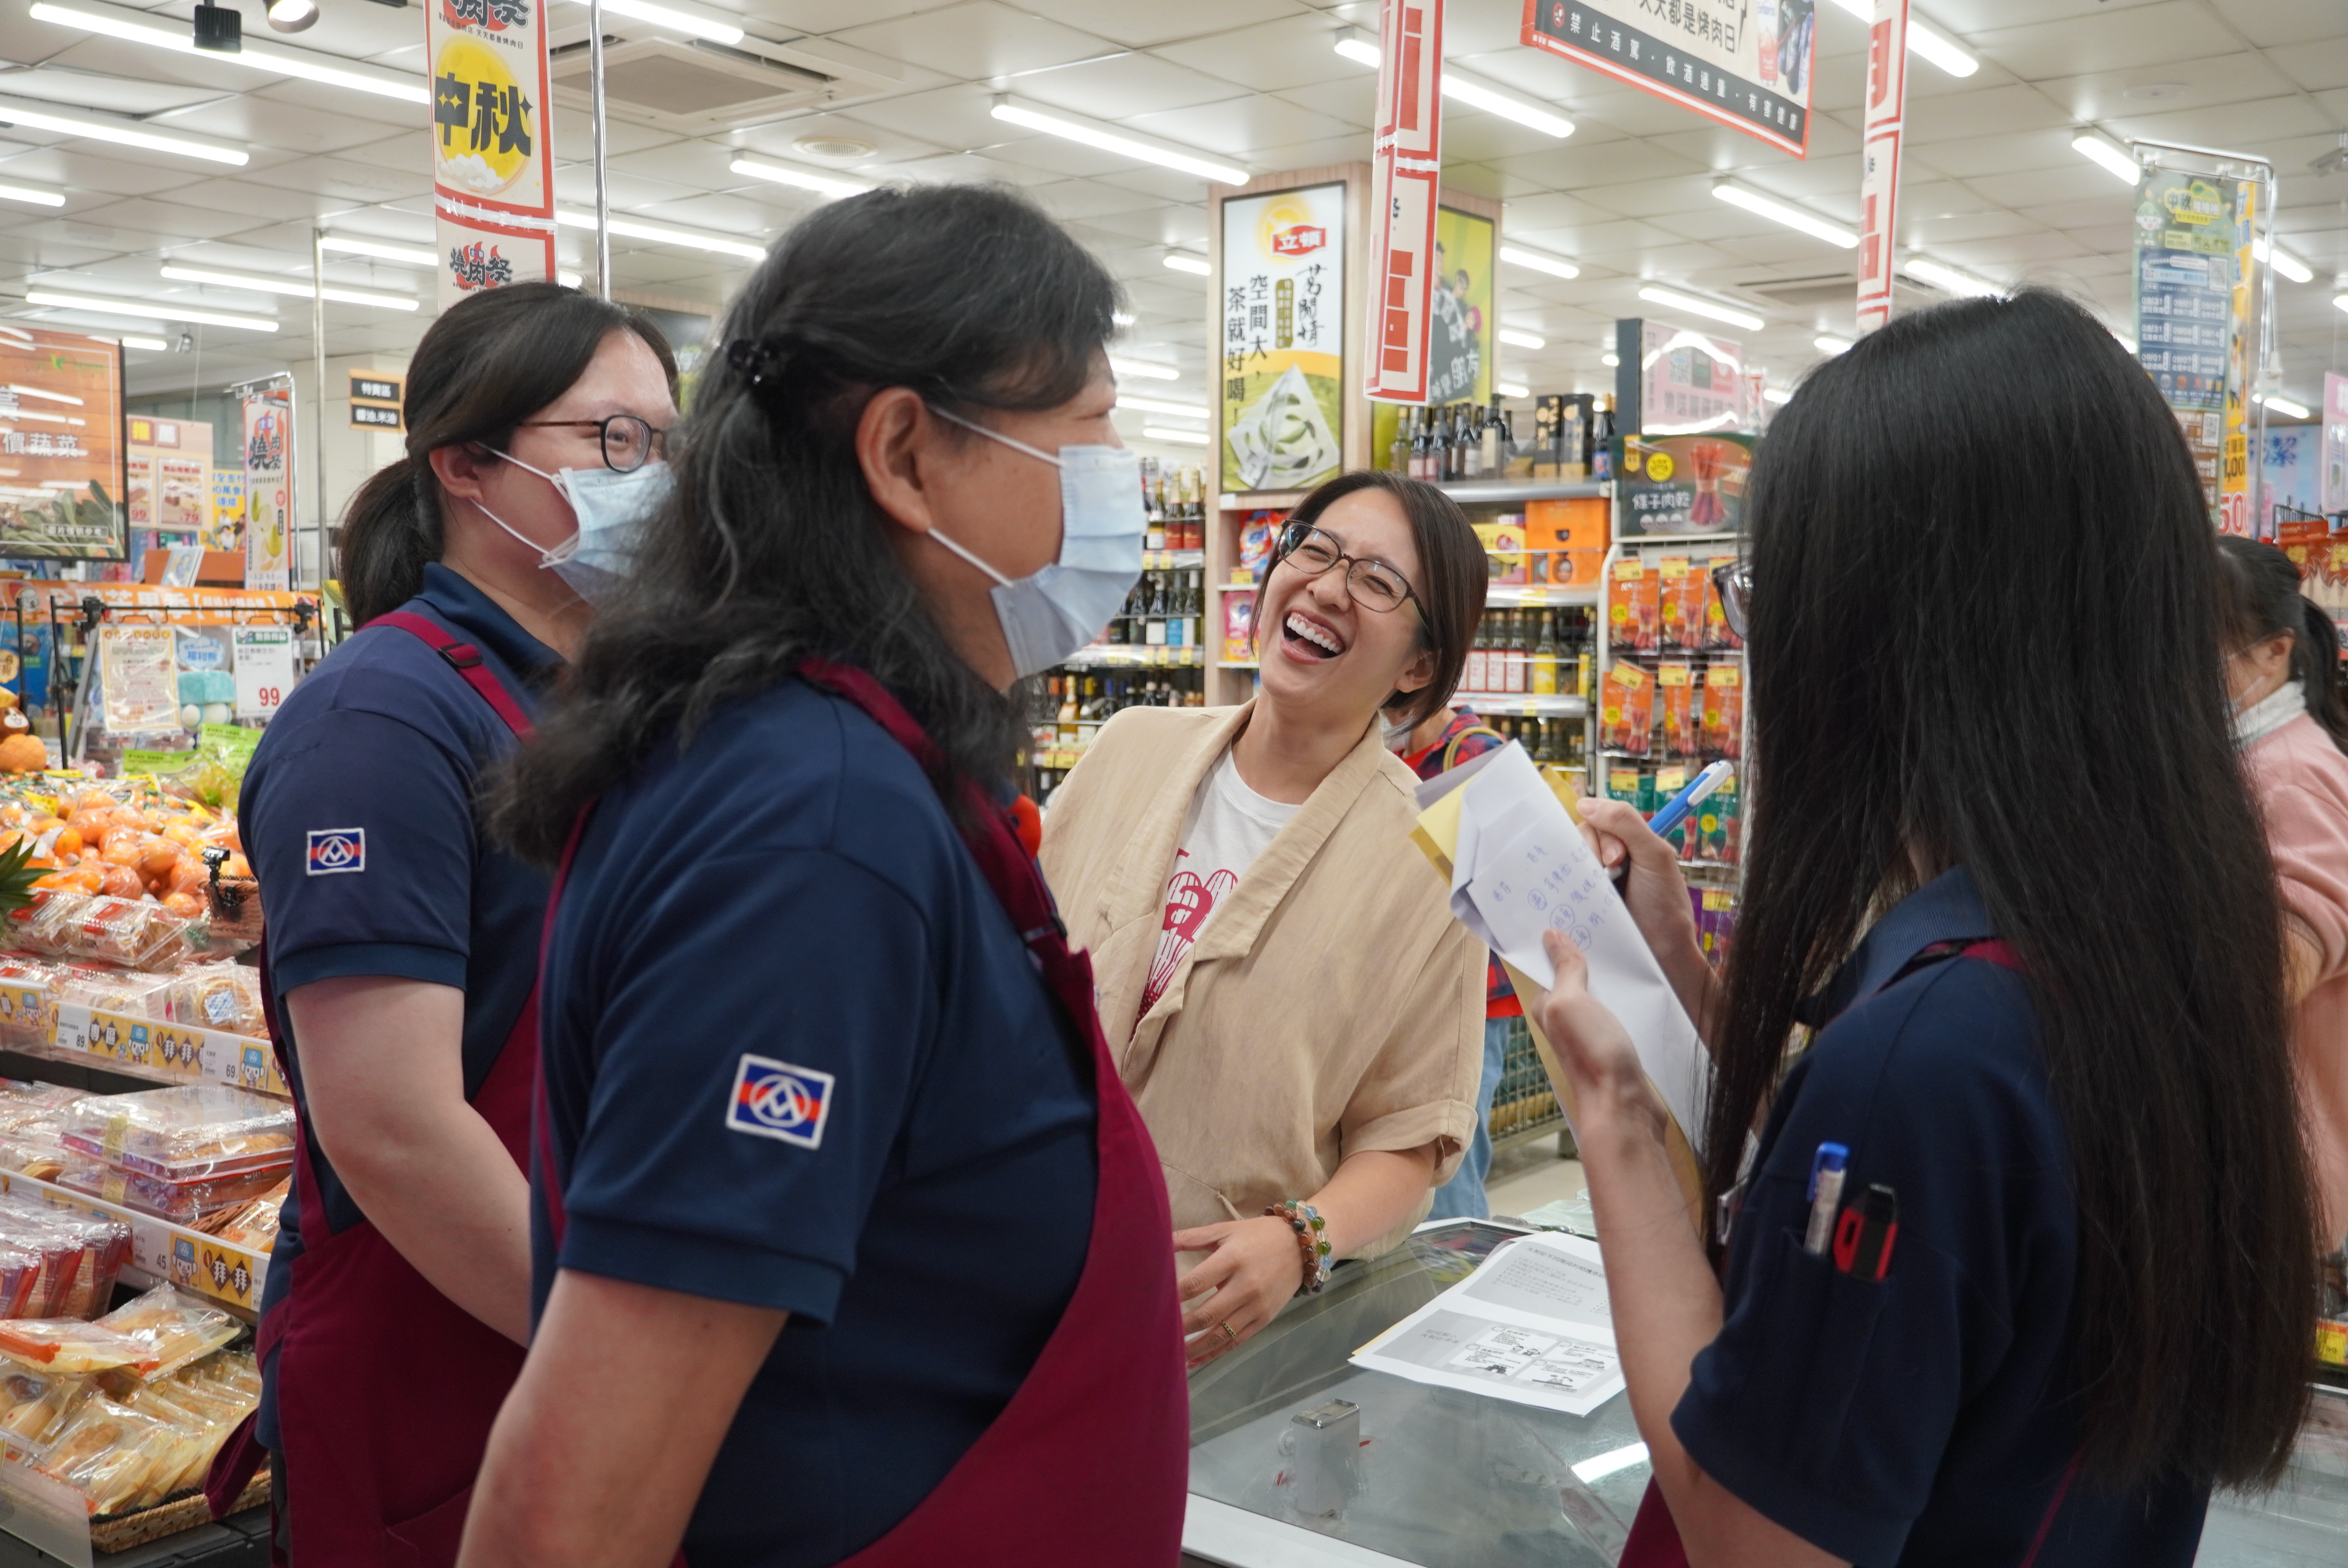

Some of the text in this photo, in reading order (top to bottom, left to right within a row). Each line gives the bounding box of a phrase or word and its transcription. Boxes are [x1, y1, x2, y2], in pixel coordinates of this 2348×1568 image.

[476, 29, 523, 49] 天天都是烤肉日
[434, 72, 533, 157] 中秋
[1278, 231, 1322, 251] 立頓
[449, 247, 514, 287] 燒肉祭
[259, 687, 280, 706] 99
[76, 1034, 85, 1048] 89
[226, 1064, 236, 1079] 69
[156, 1254, 166, 1270] 45
[214, 1260, 247, 1291] 拜拜
